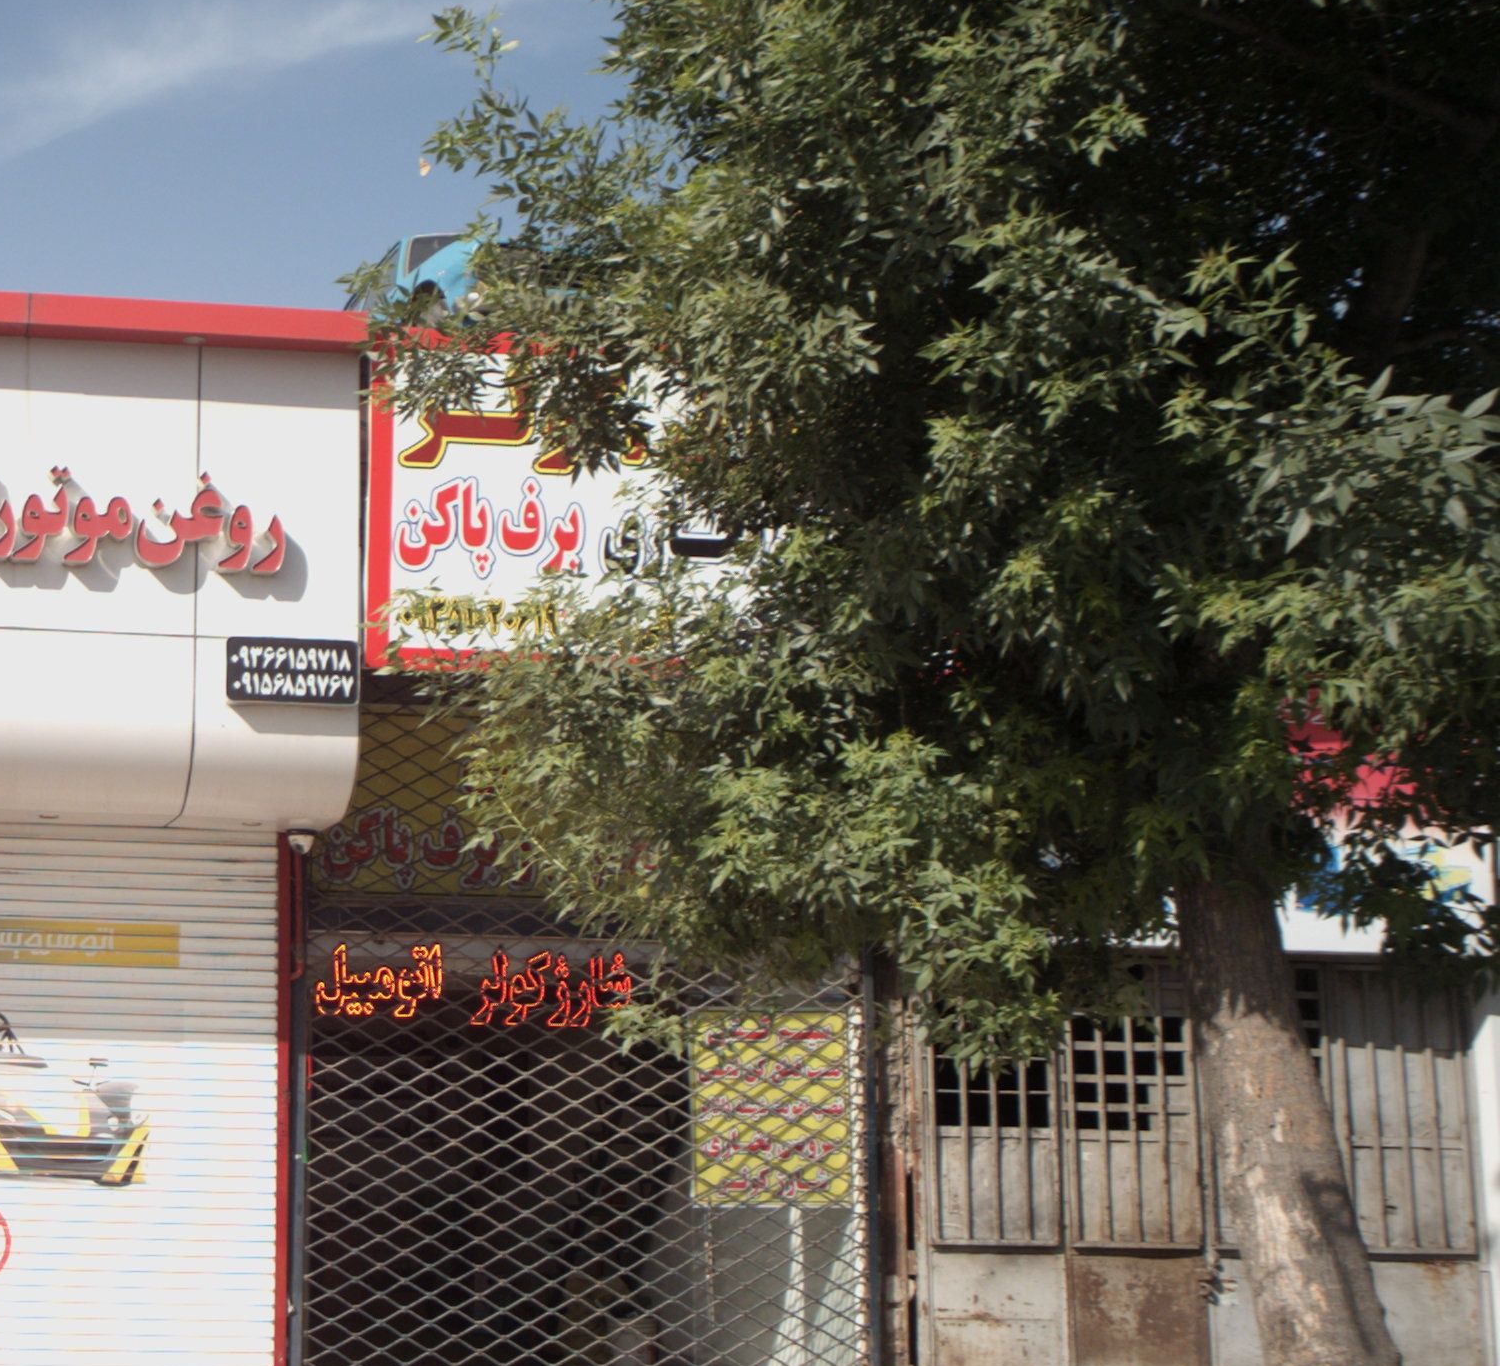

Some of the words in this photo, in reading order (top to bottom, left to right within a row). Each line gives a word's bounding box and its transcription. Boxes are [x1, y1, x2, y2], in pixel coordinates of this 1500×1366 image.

[134, 471, 286, 575] روغن
[394, 477, 494, 579] پاکن
[498, 476, 586, 575] برف
[231, 645, 352, 672] ۰۹۳۶۶۱۵۹۷۱۸
[233, 671, 354, 698] ۰۹۱۵۶۸۵۹۷۶۷
[315, 942, 443, 1019] اتومبیل
[469, 946, 551, 1026] کولر
[547, 950, 633, 1028] شارژ
